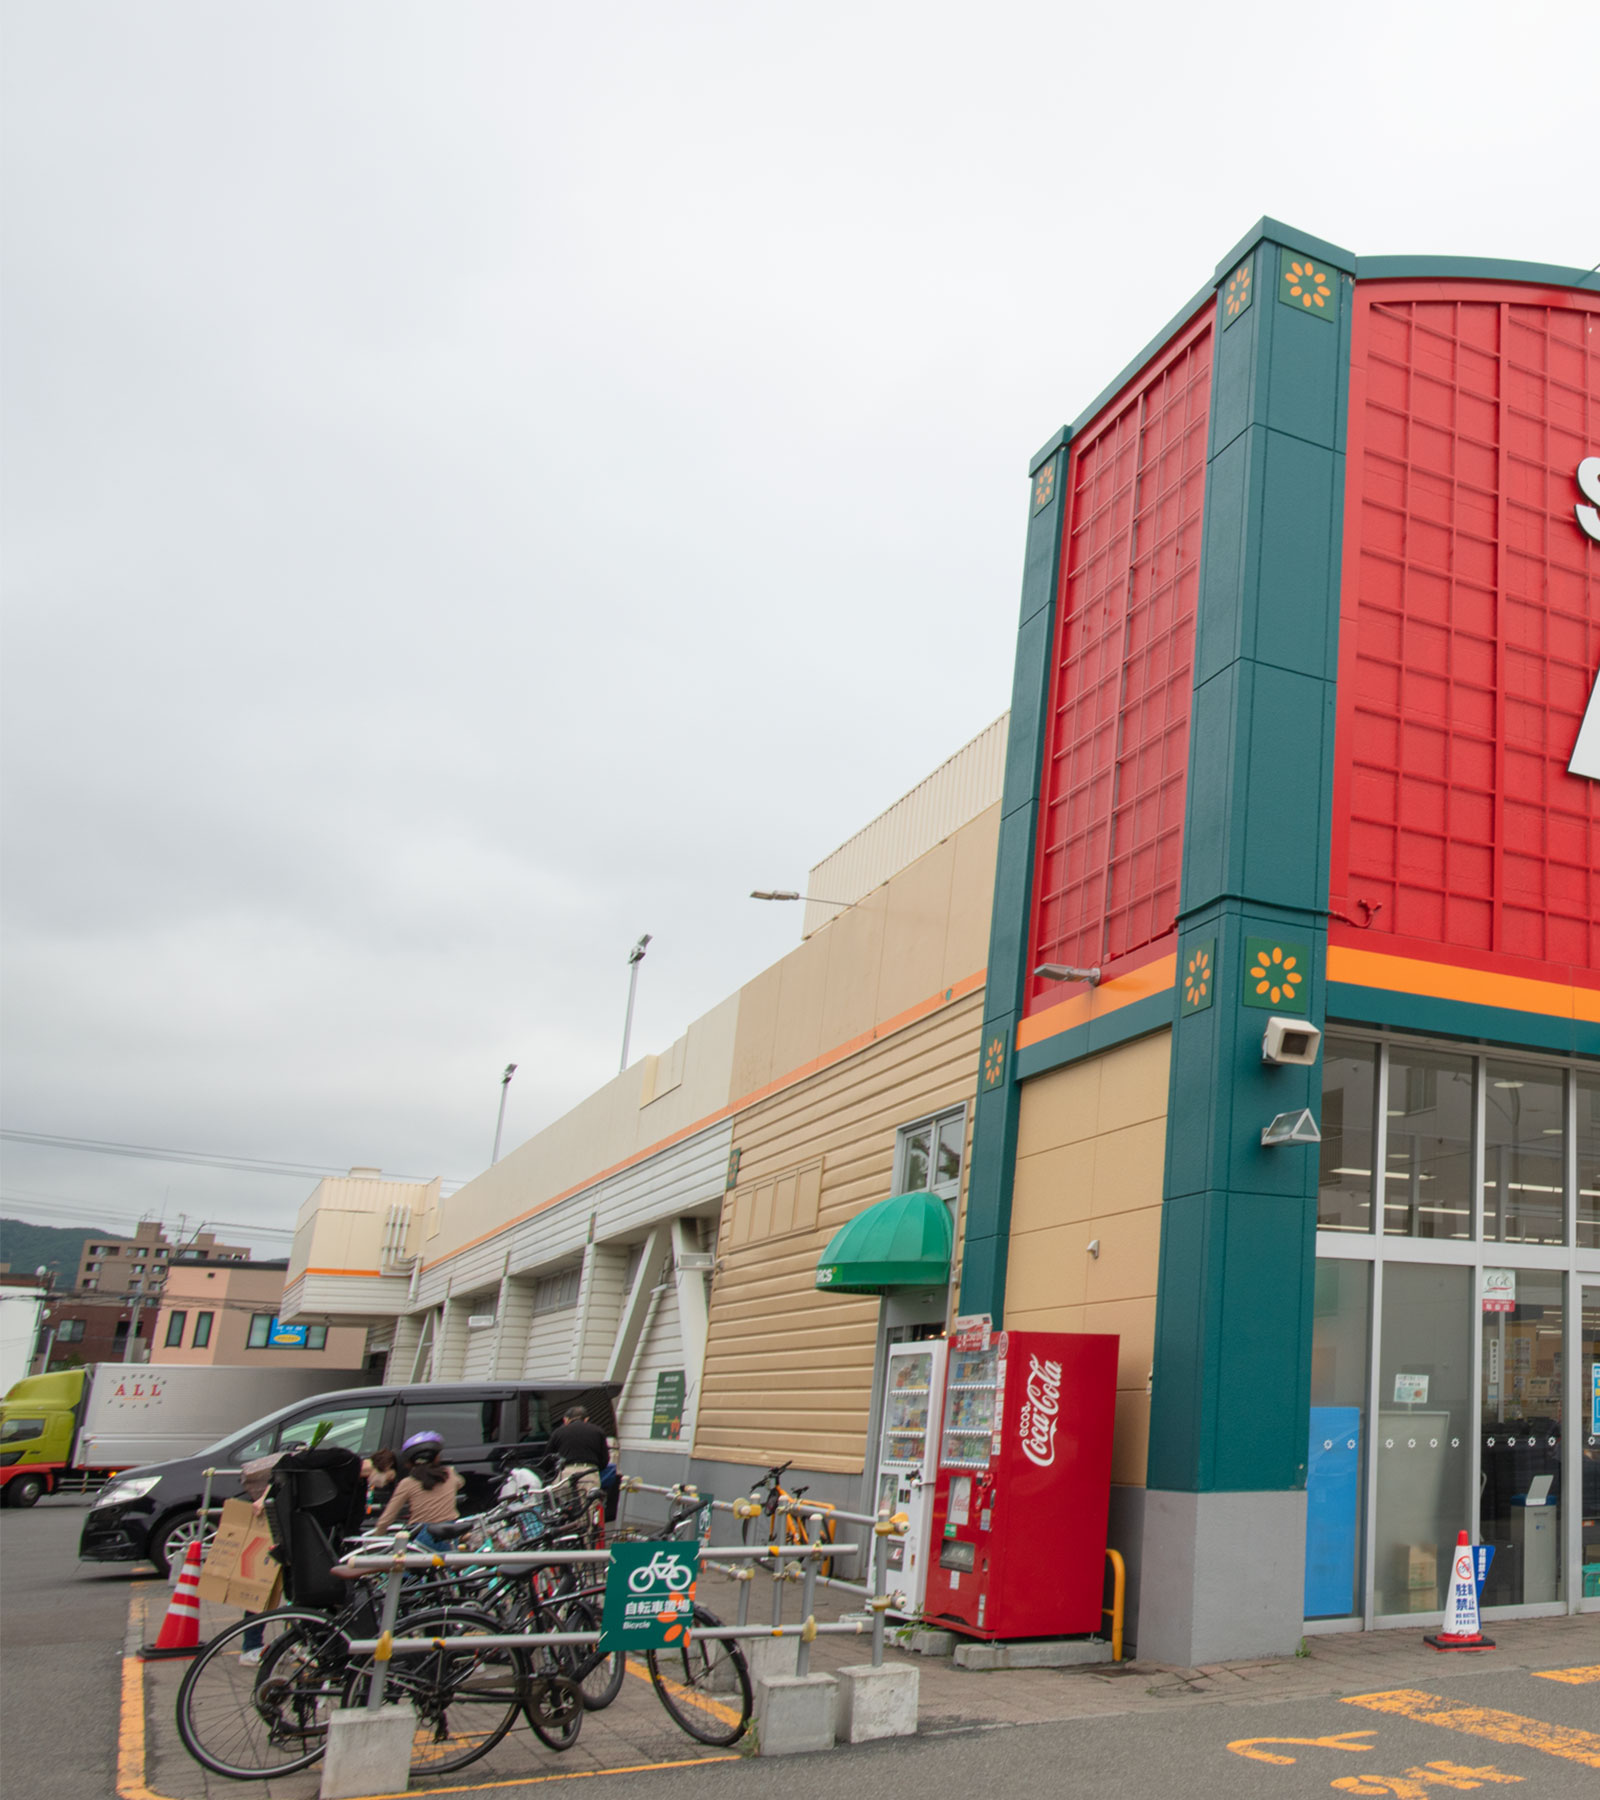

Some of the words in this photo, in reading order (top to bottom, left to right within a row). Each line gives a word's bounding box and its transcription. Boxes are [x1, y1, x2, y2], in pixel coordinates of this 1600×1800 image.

[114, 1383, 162, 1397] ALL
[1022, 1353, 1062, 1467] Coca-Cola
[625, 1600, 691, 1616] 自転車置場
[622, 1621, 651, 1631] Bicycle
